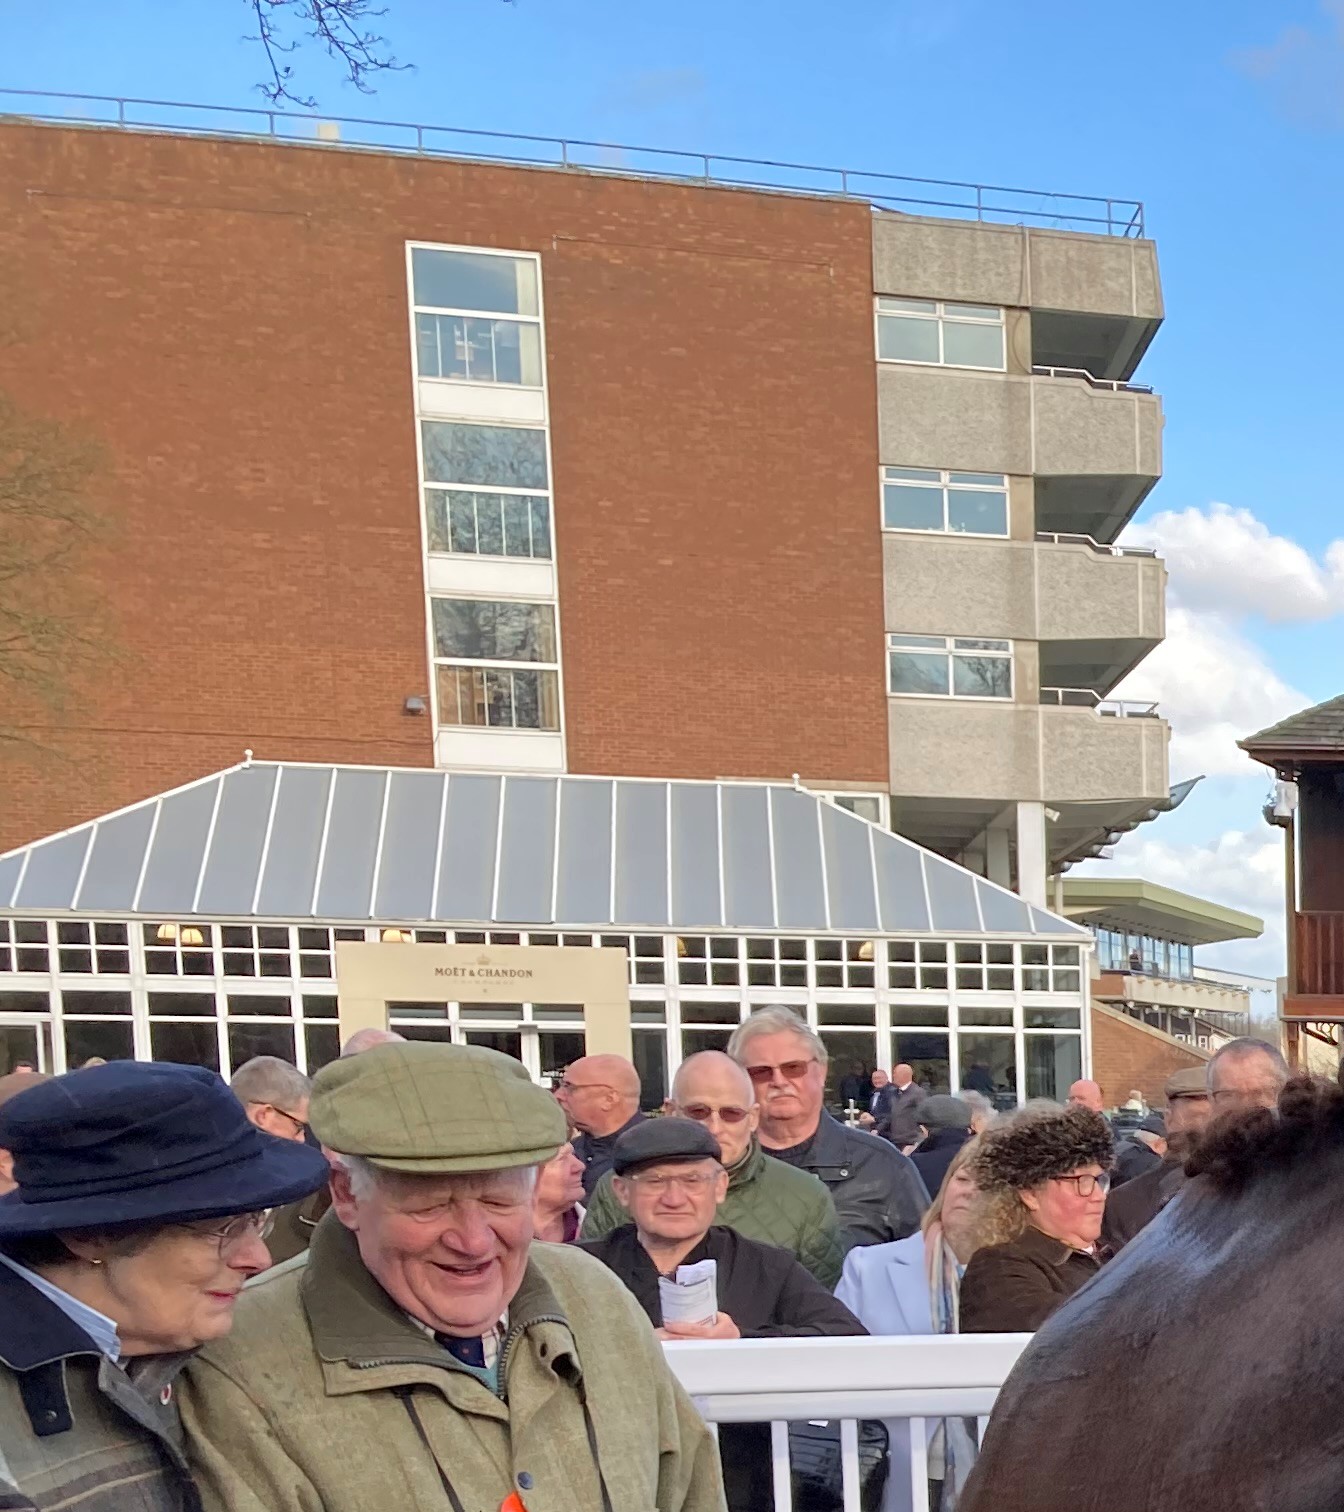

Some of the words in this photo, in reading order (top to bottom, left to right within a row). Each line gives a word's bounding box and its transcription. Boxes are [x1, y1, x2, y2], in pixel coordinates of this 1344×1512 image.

[434, 967, 466, 977] MOËT
[469, 969, 475, 977] &
[477, 968, 533, 978] CHANDON
